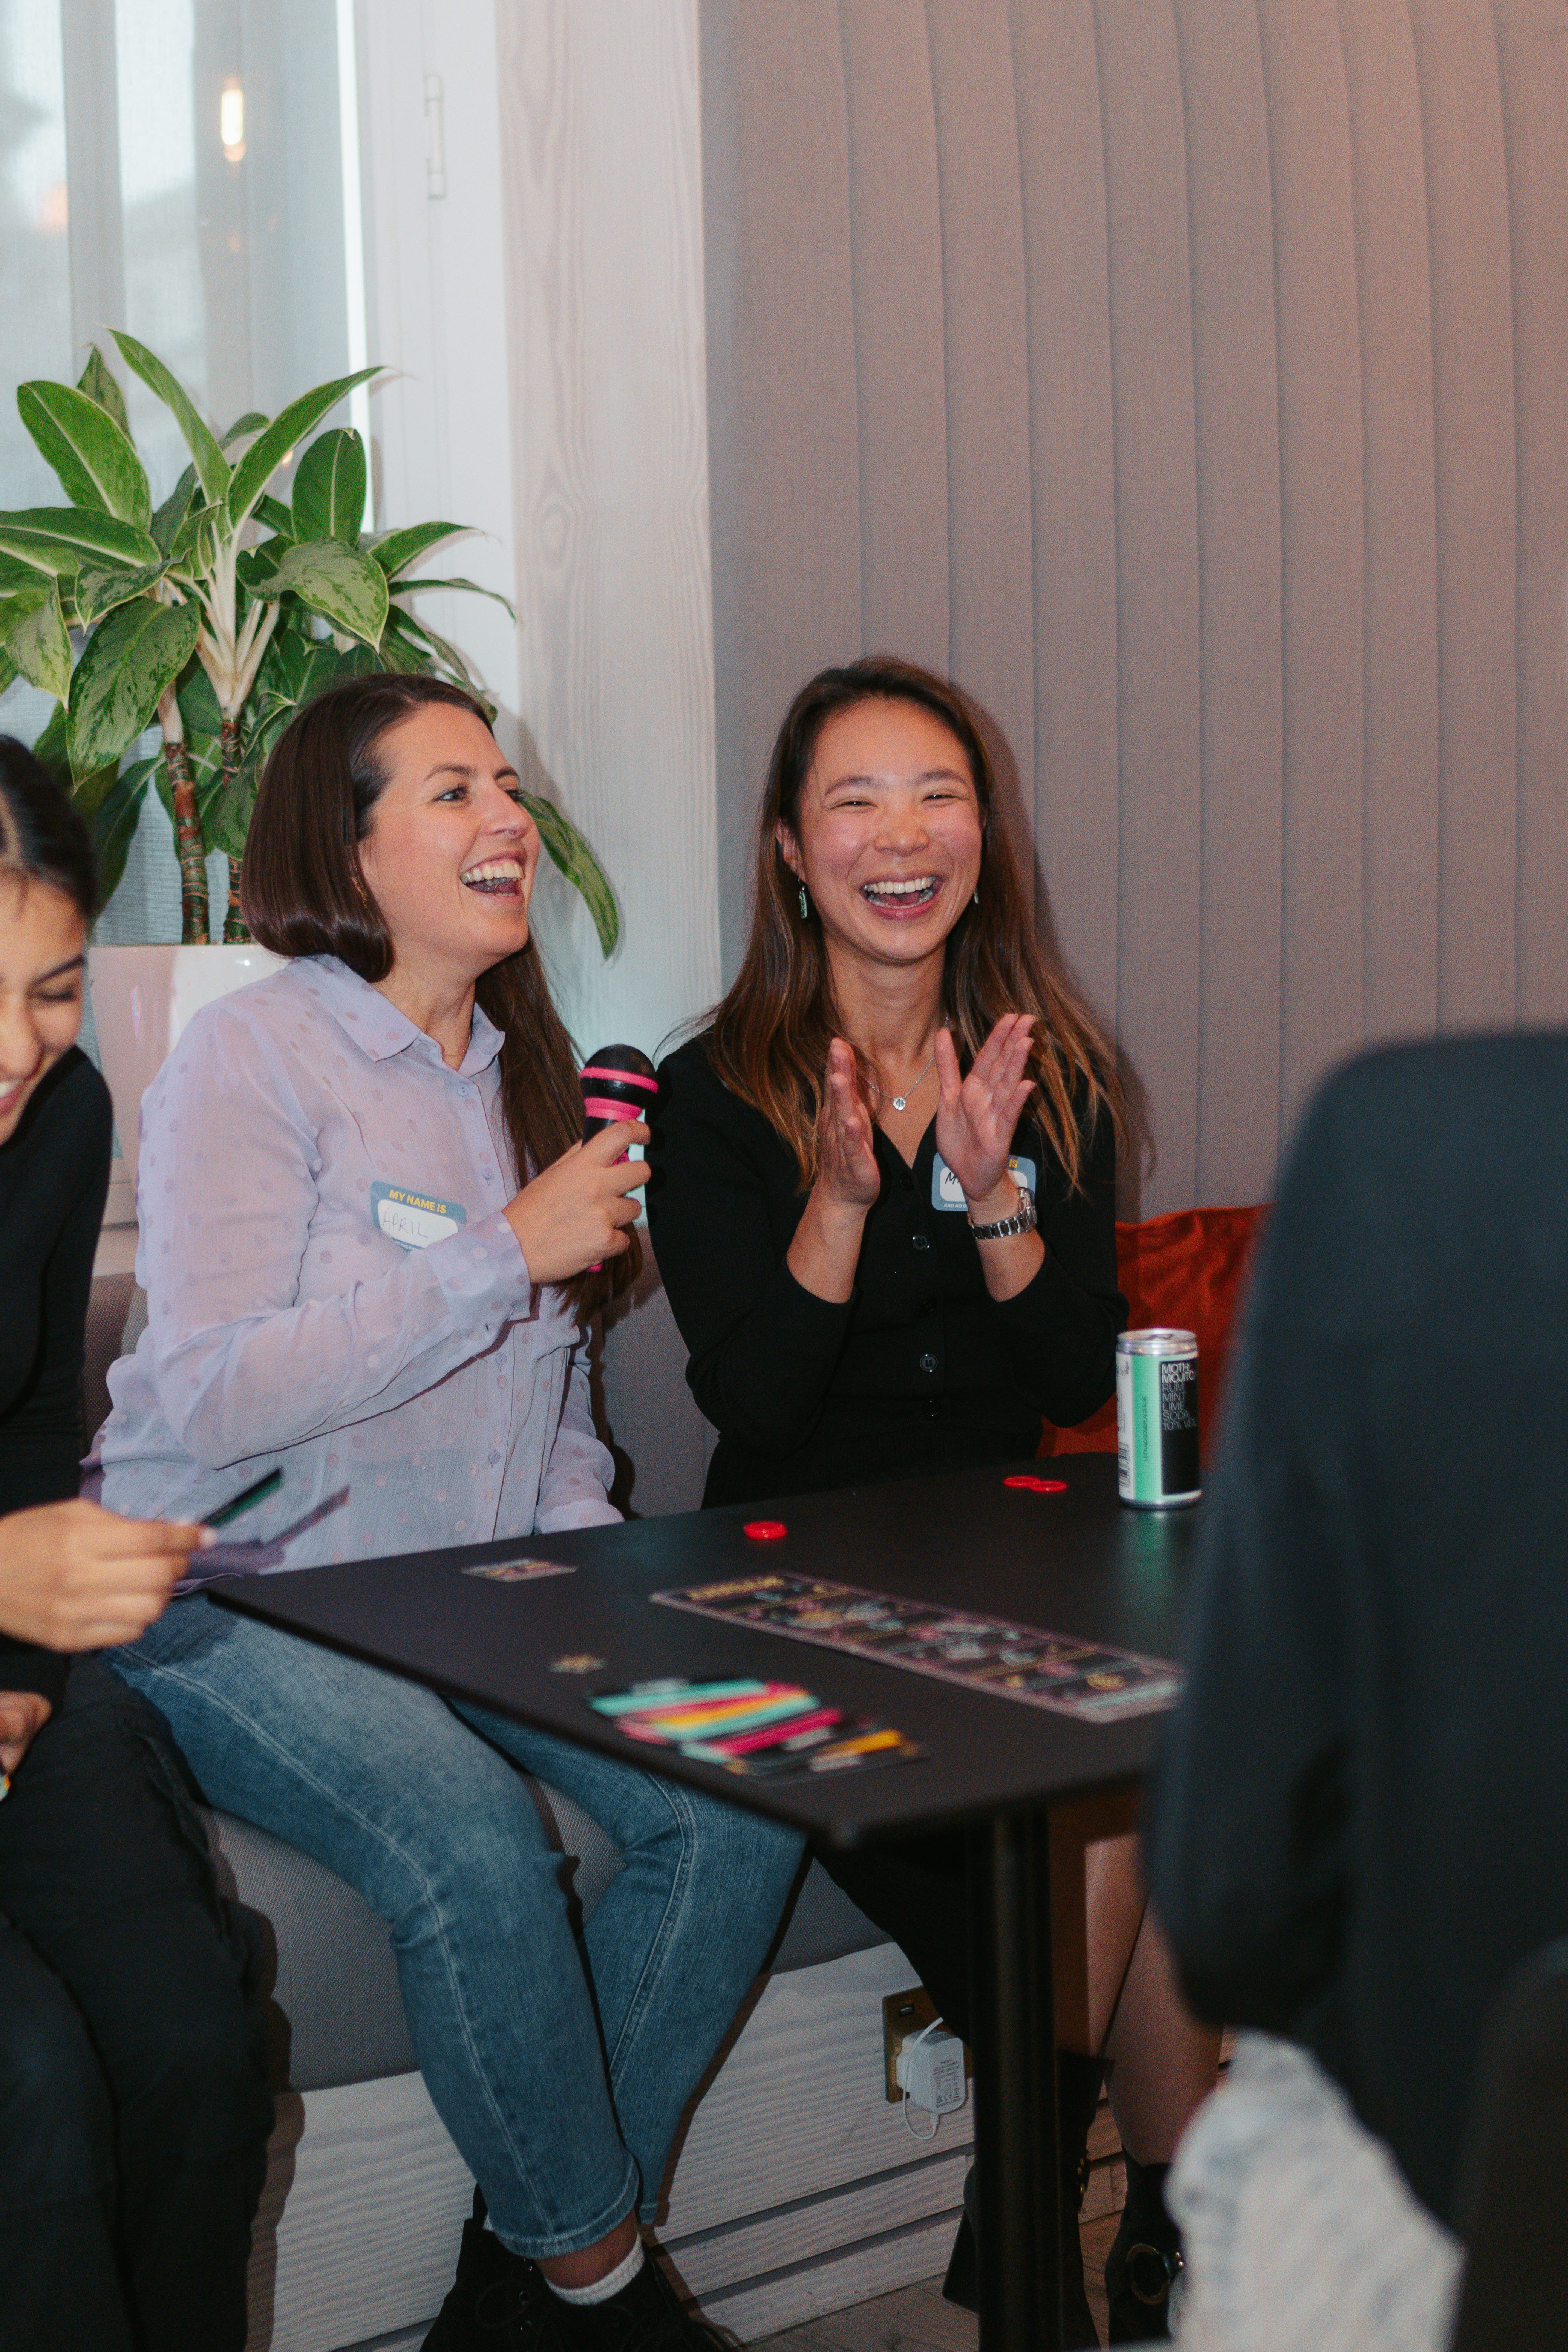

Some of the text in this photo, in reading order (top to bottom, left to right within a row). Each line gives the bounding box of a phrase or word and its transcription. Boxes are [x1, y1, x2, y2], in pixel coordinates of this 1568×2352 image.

[1009, 1159, 1018, 1168] IS
[389, 1190, 447, 1214] MY NAME IS
[383, 1207, 428, 1238] APRIL
[1162, 1370, 1194, 1383] MOJITO
[1162, 1382, 1184, 1393] RUM
[1162, 1391, 1185, 1403] MINT
[1162, 1400, 1185, 1412] LIME
[1162, 1410, 1189, 1421] SODA
[1164, 1420, 1182, 1431] 10%
